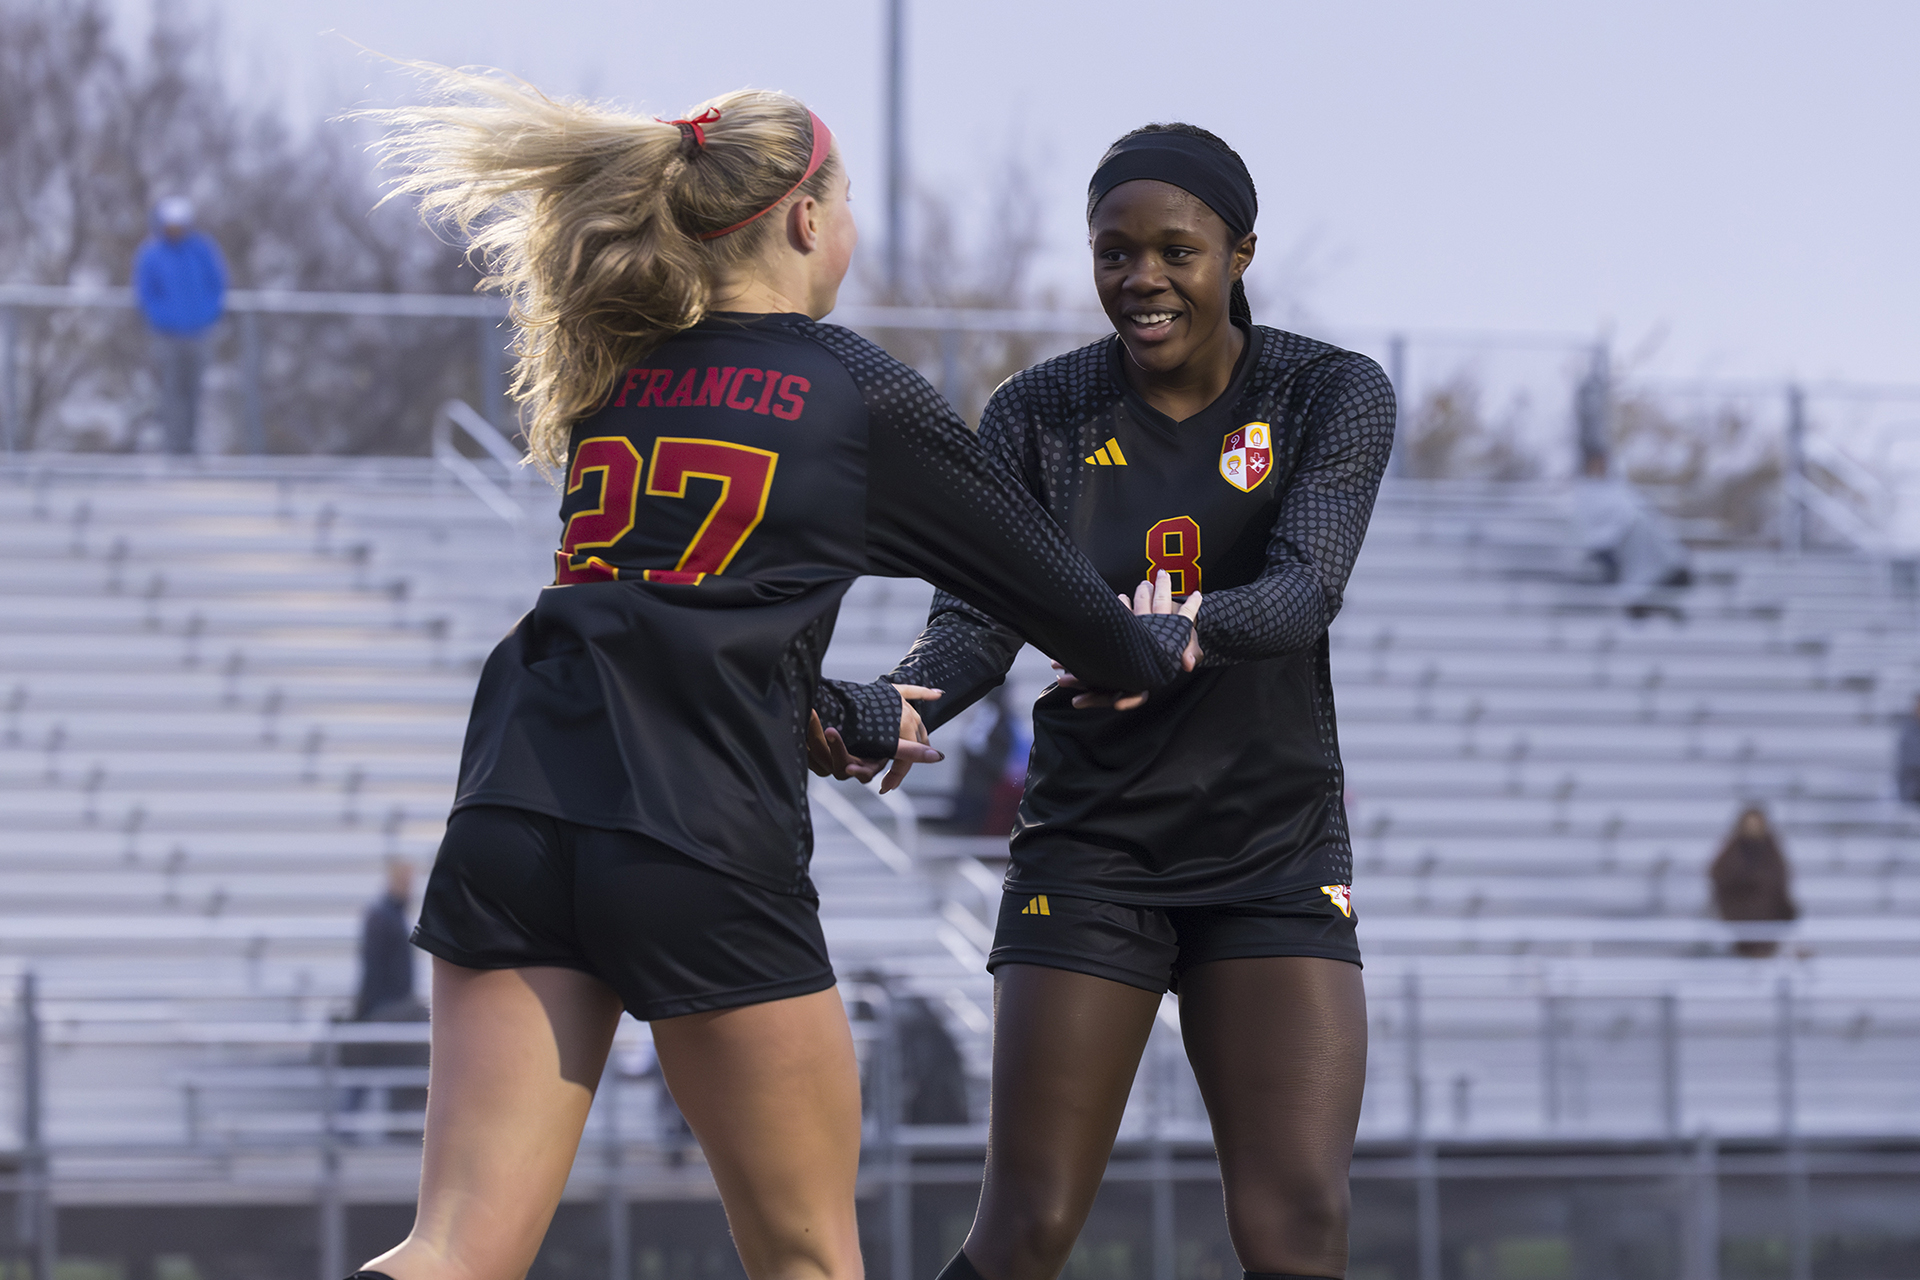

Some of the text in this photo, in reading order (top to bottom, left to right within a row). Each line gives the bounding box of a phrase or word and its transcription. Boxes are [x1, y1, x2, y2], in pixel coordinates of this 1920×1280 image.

[614, 366, 811, 421] FRANCIS
[555, 436, 779, 586] 27
[1145, 515, 1202, 597] 8
